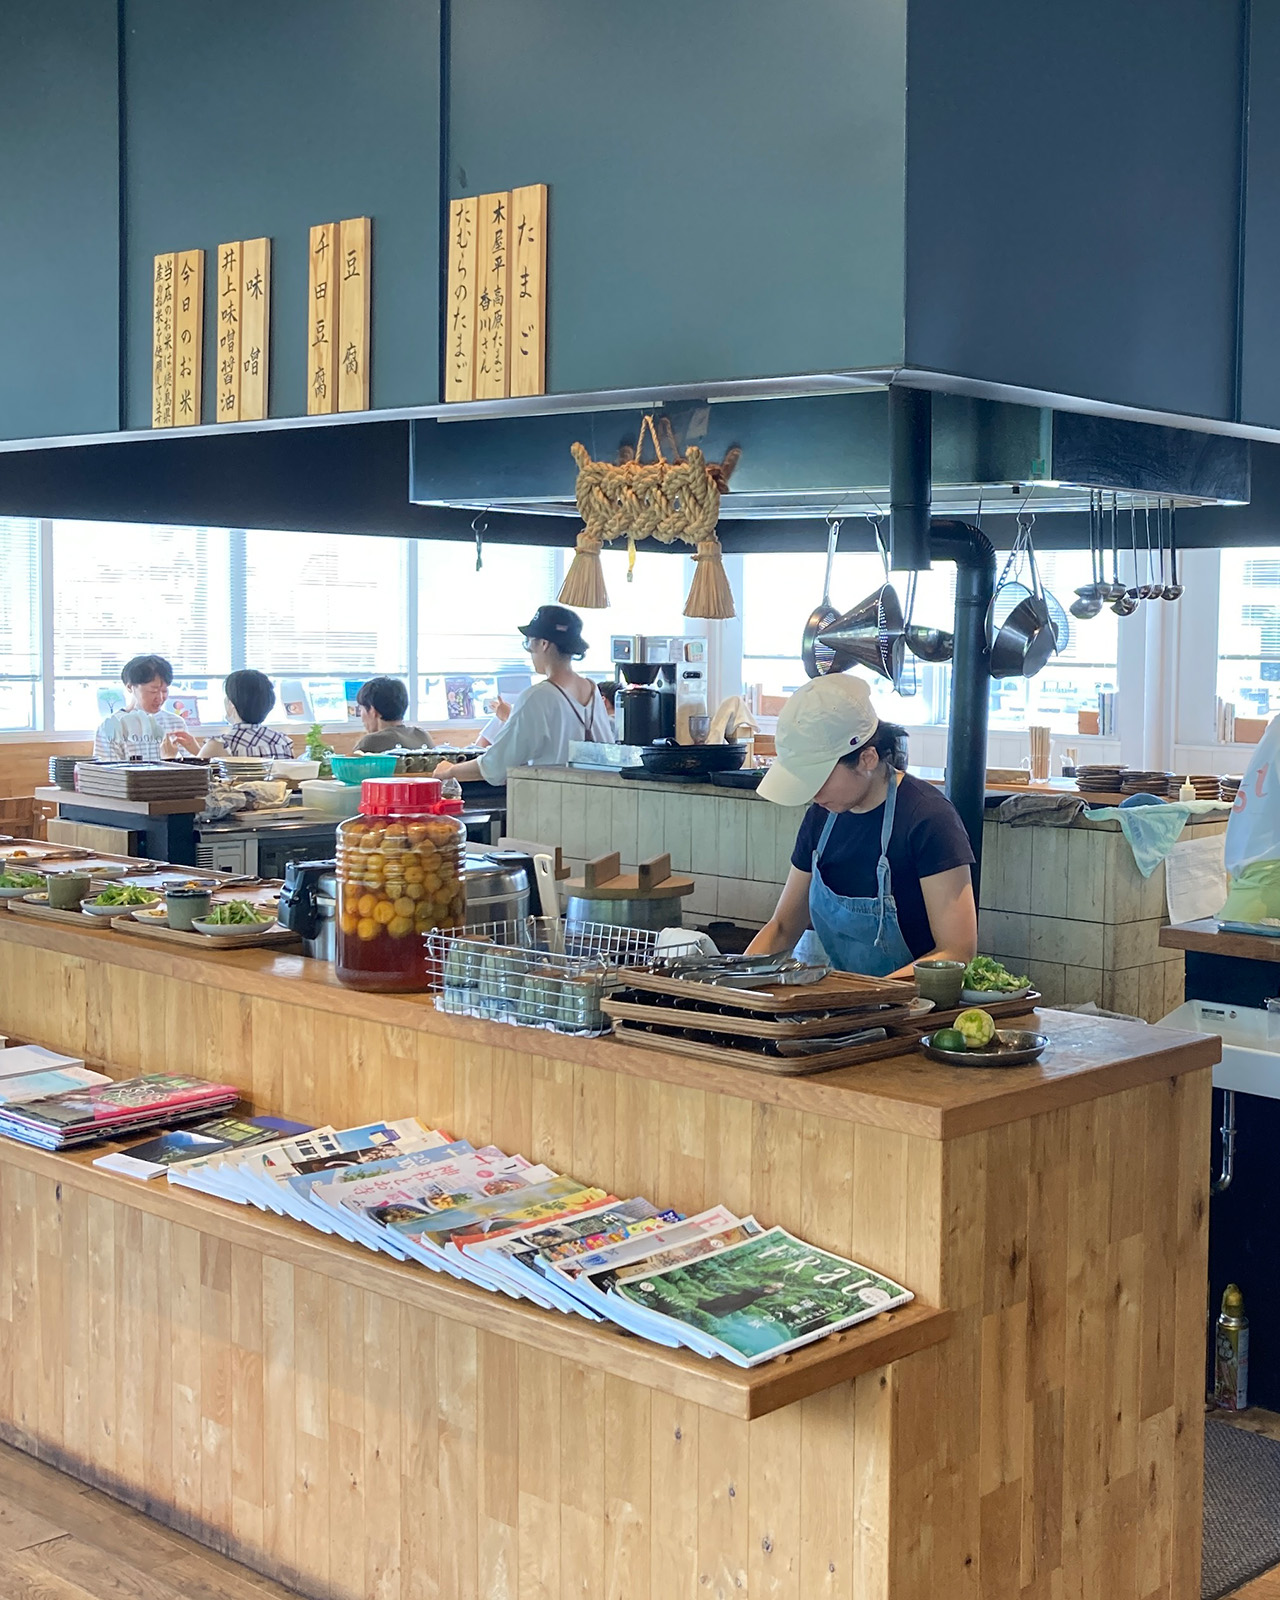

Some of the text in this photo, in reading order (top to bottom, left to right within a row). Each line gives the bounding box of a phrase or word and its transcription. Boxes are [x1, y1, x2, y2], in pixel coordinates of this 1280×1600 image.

[180, 260, 195, 415] 今日のお米
[244, 268, 262, 376] 味噌
[312, 232, 329, 399] 千田豆腐
[342, 250, 360, 375] 豆腐
[453, 203, 471, 383] たむらのたまご
[518, 214, 535, 356] たまご
